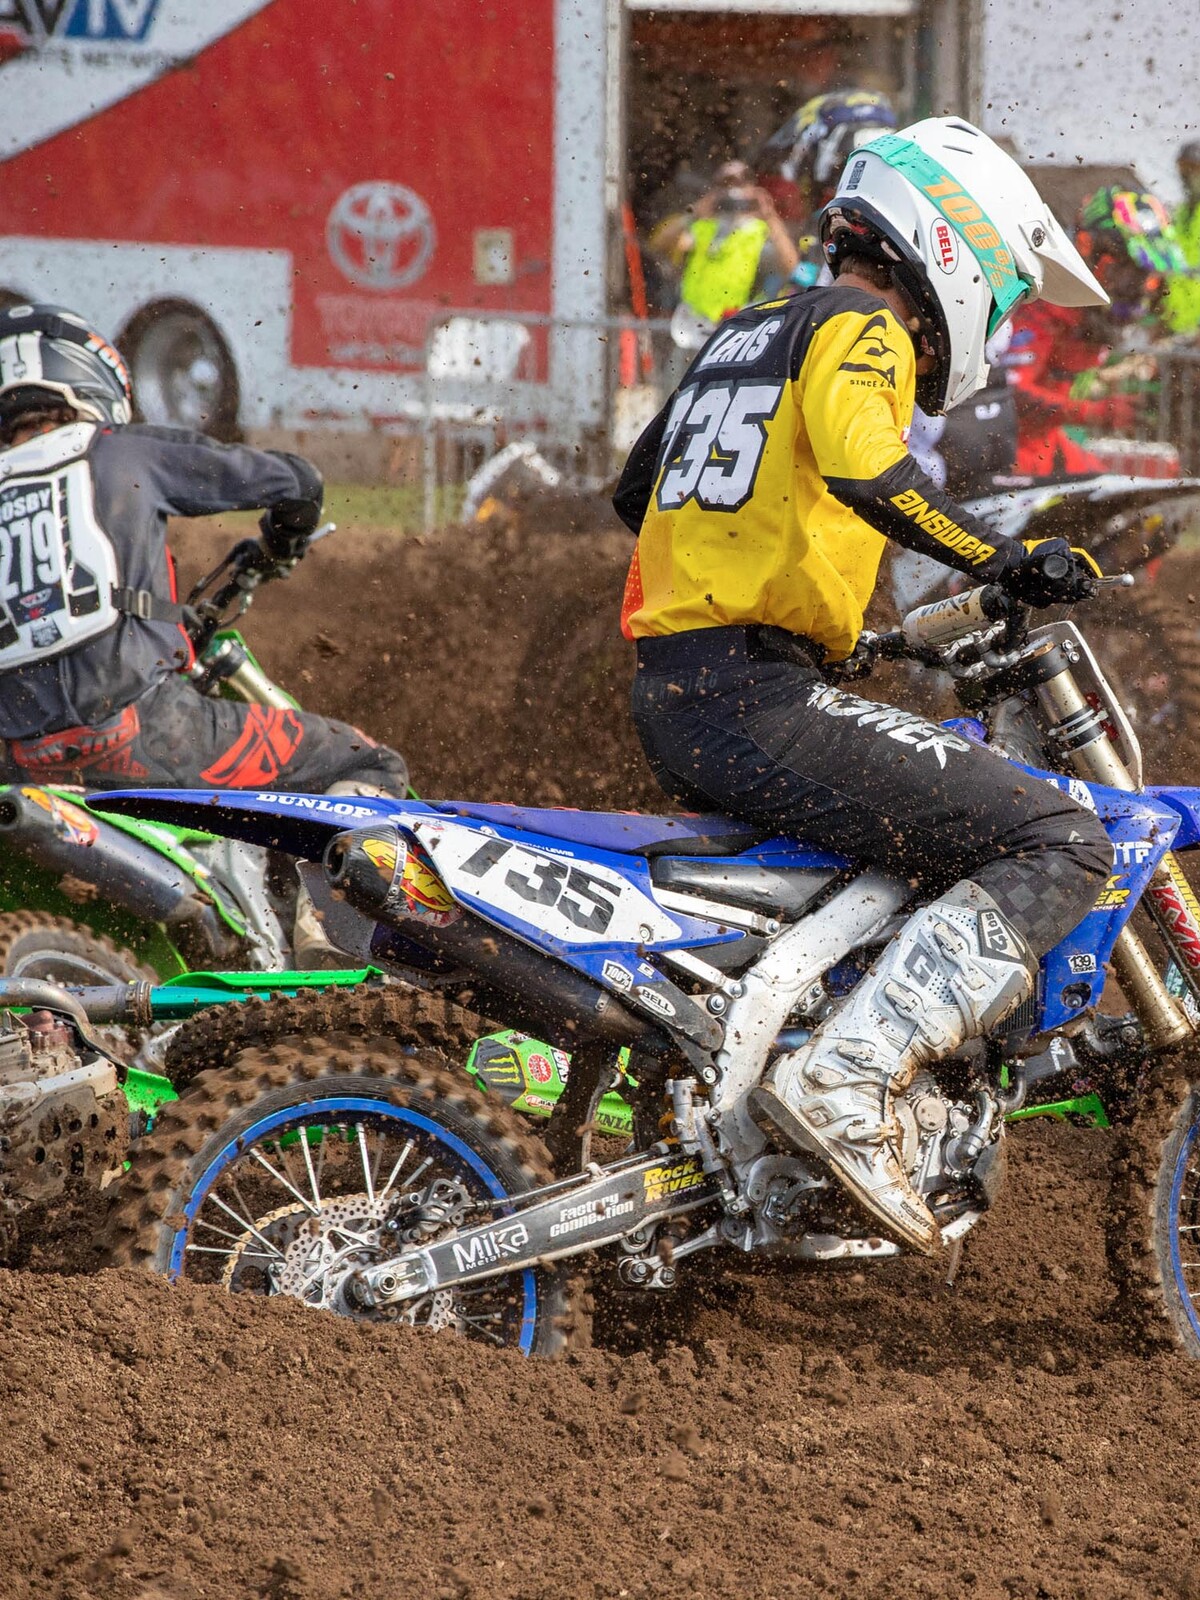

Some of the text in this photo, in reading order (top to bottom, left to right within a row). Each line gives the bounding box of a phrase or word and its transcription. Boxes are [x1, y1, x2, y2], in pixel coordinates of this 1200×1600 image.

[924, 175, 1016, 288] 100%
[936, 226, 955, 267] BELL
[849, 379, 878, 389] SINCE
[0, 510, 62, 600] 279
[256, 793, 373, 819] DUNLOP
[458, 836, 622, 934] 735
[606, 965, 633, 988] 100%
[642, 989, 673, 1014] BELL
[452, 1220, 529, 1273] Mika
